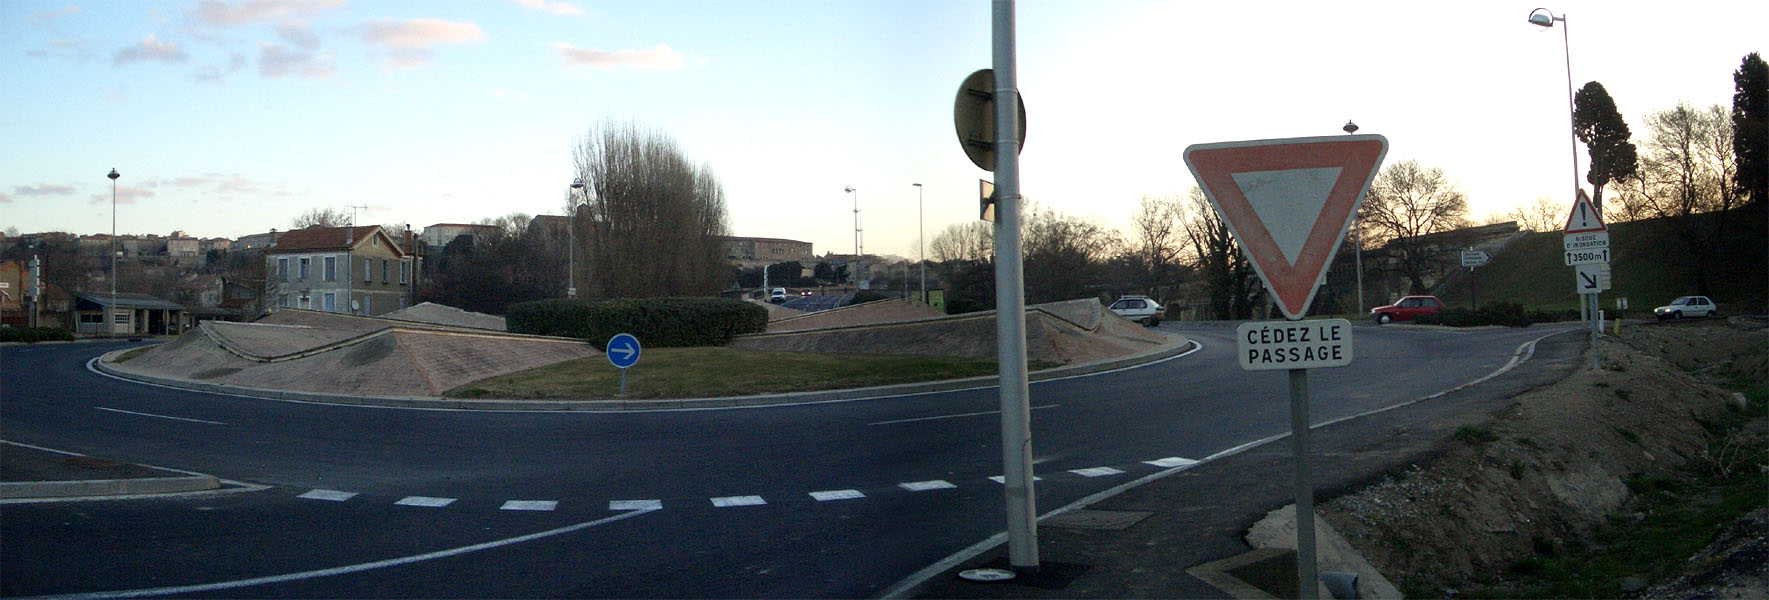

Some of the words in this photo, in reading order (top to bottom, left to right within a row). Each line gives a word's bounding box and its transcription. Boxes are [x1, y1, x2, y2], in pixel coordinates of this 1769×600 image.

[1247, 326, 1311, 344] CÉDEZ
[1320, 326, 1341, 341] LE
[1248, 345, 1342, 364] PASSAGE
